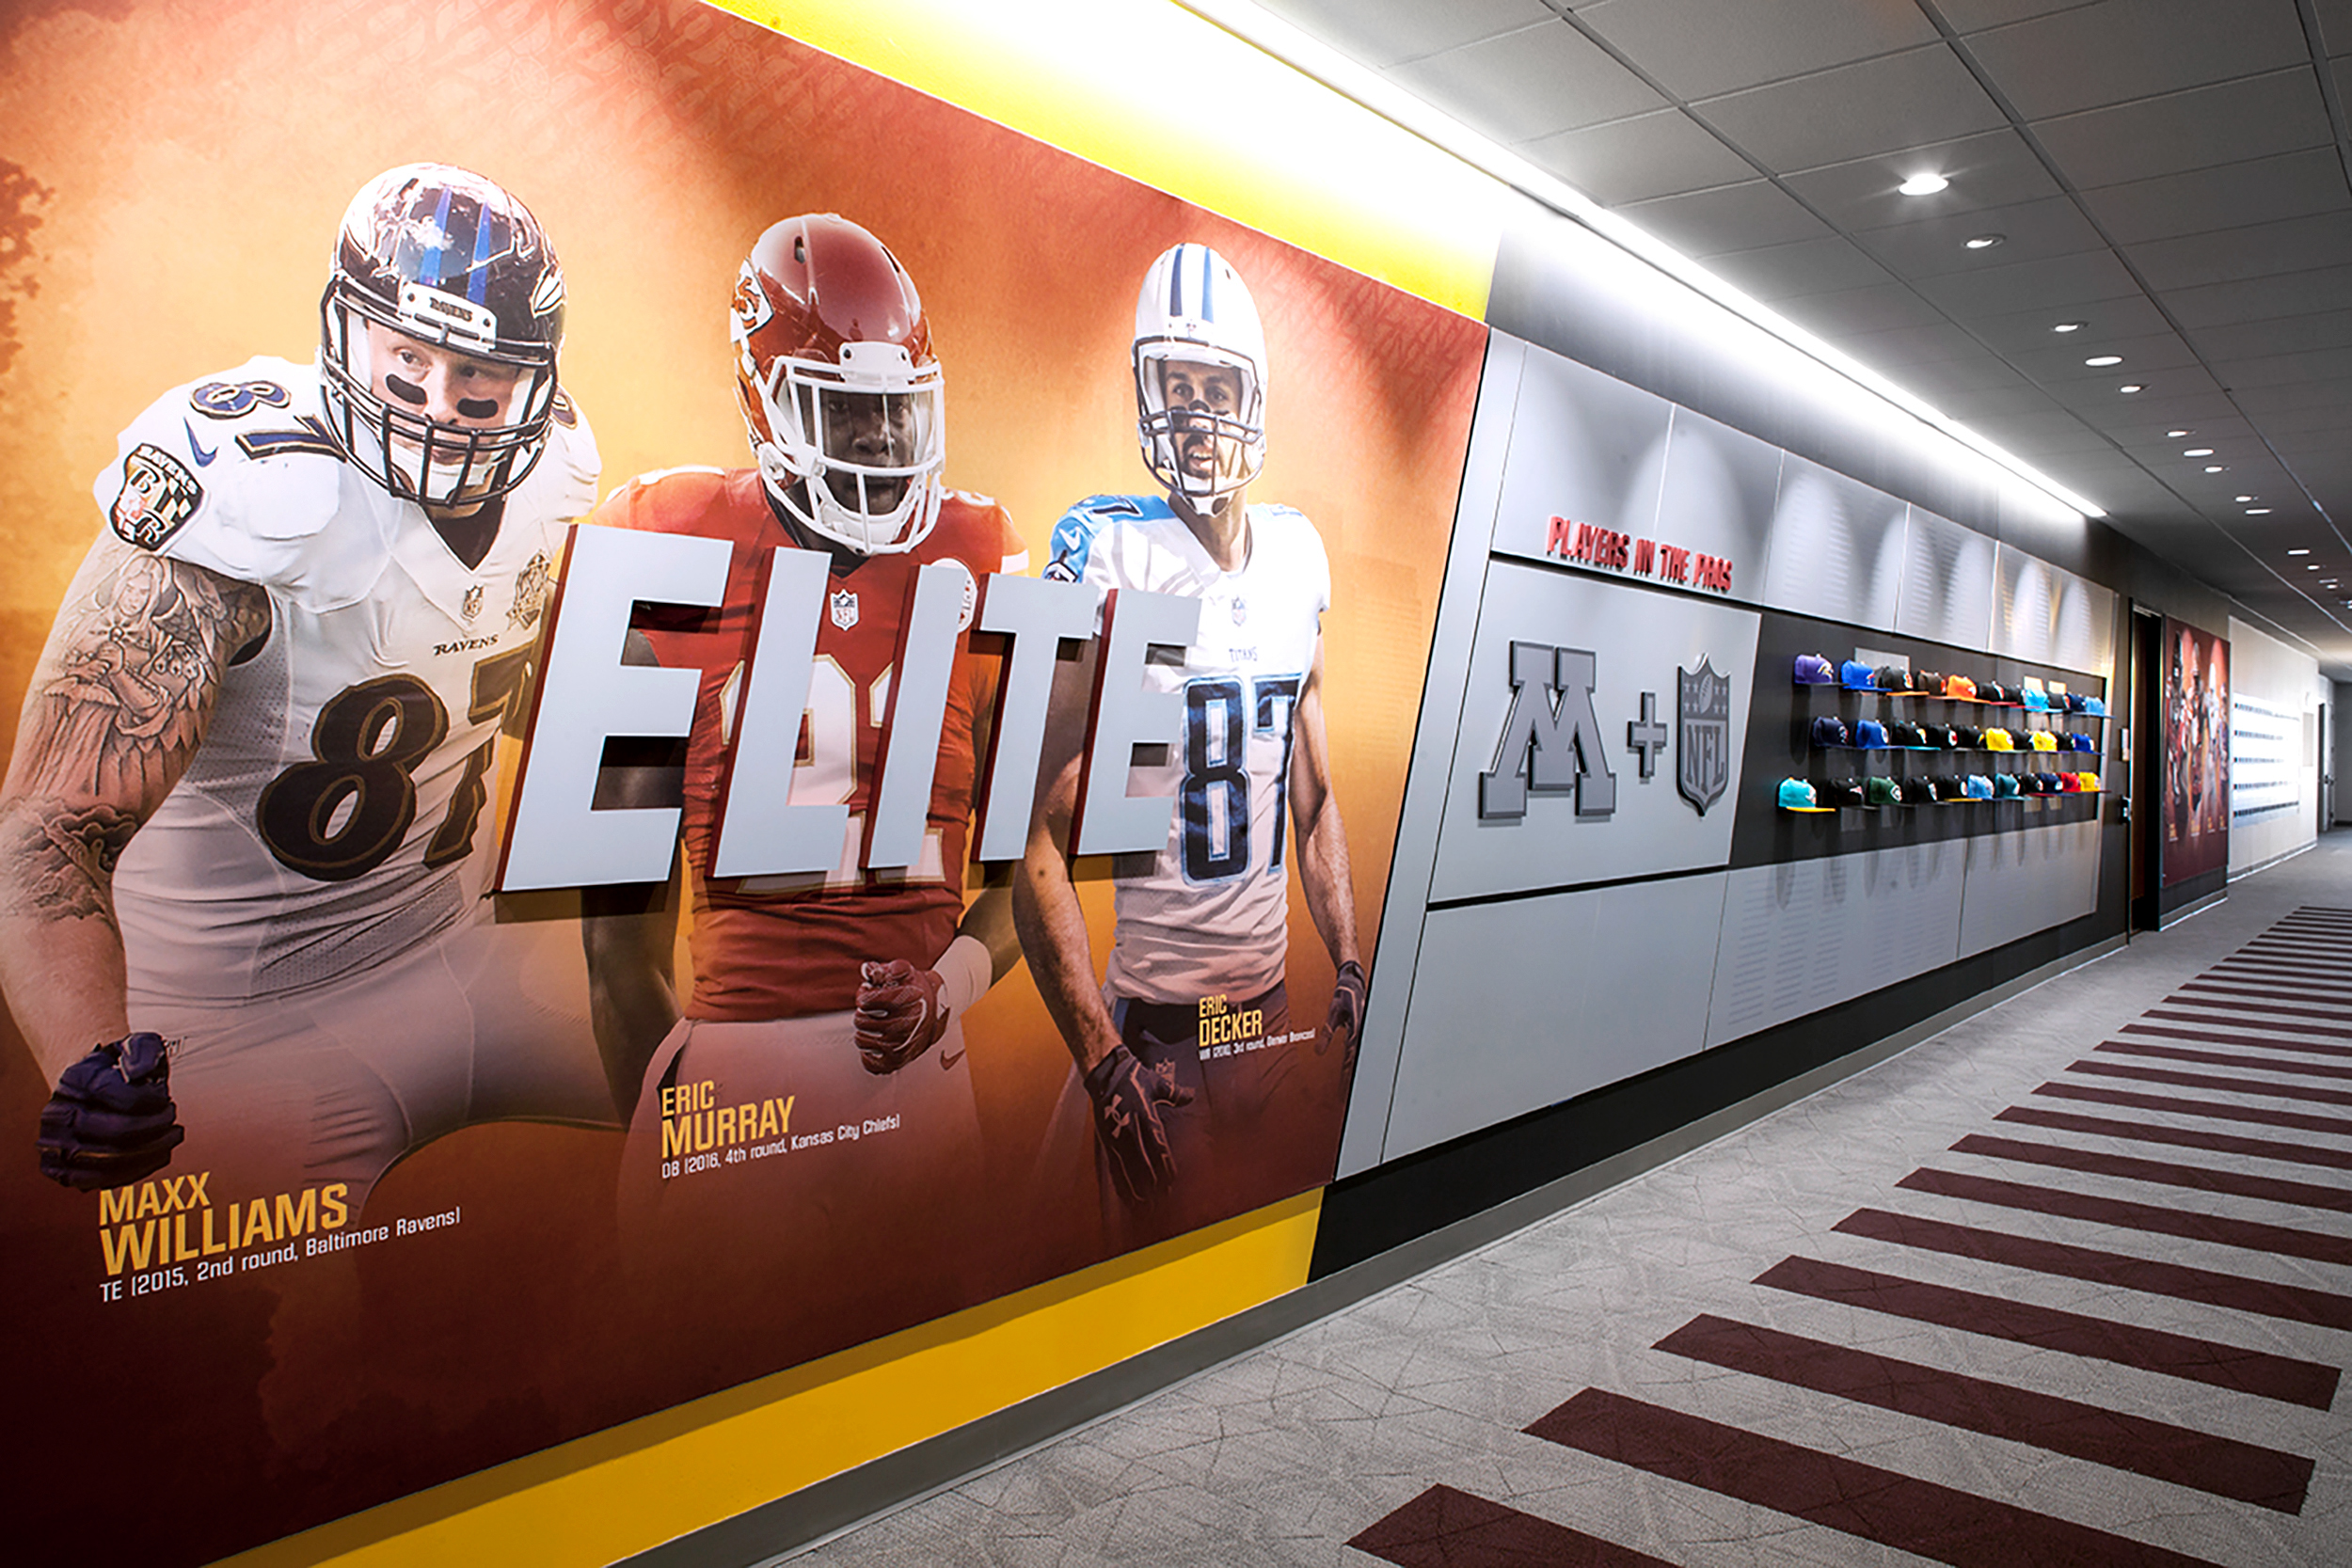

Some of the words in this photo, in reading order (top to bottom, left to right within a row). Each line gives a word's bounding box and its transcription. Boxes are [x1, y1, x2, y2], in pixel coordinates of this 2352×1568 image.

[1548, 515, 1629, 570] PLAYERS
[1634, 539, 1656, 577] IN
[1660, 544, 1691, 585] THE
[433, 634, 499, 657] RAVENS
[494, 523, 1202, 893] ELITE
[1478, 641, 1616, 819] M
[1685, 723, 1725, 796] NFL
[256, 636, 538, 882] 87
[1180, 672, 1302, 887] 87
[1199, 994, 1227, 1018] ERIC
[1199, 1009, 1263, 1047] DECKER
[661, 1080, 715, 1117] ERIC
[661, 1095, 796, 1159] MURRAY
[725, 1148, 746, 1164] 4th
[750, 1138, 787, 1159] round,
[790, 1130, 834, 1151] Kansas
[837, 1124, 860, 1141] City
[99, 1171, 211, 1226] MAXX
[100, 1182, 348, 1276] WILLIAMS
[100, 1280, 123, 1303] TE
[197, 1258, 234, 1282] 2nd
[242, 1243, 299, 1273] round,
[306, 1224, 389, 1258] Baltimore
